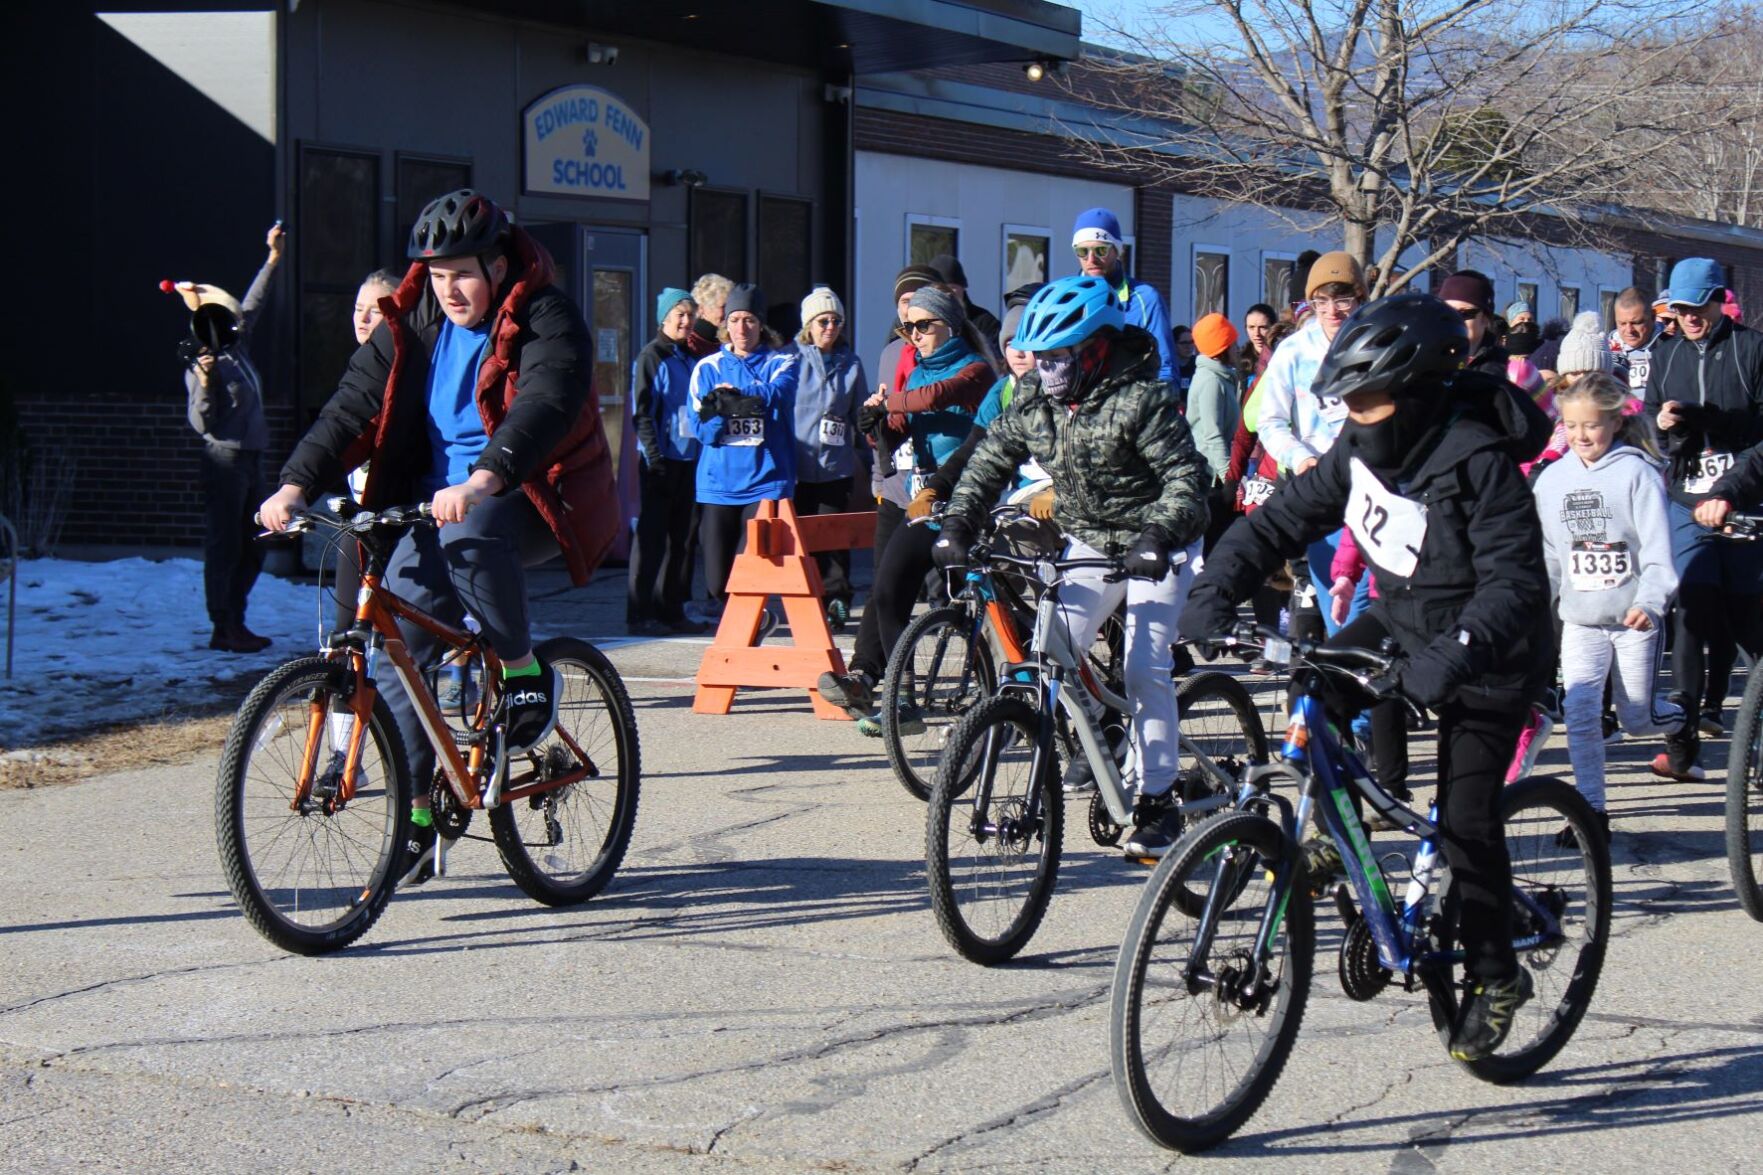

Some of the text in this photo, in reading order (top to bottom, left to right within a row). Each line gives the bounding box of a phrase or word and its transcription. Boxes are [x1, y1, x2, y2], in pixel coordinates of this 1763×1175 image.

[534, 97, 643, 152] EDWARD FENN
[553, 159, 626, 190] SCHOOL
[1560, 506, 1613, 523] BASKETBALL
[1572, 553, 1628, 575] 1335
[1340, 792, 1384, 882] GIANT
